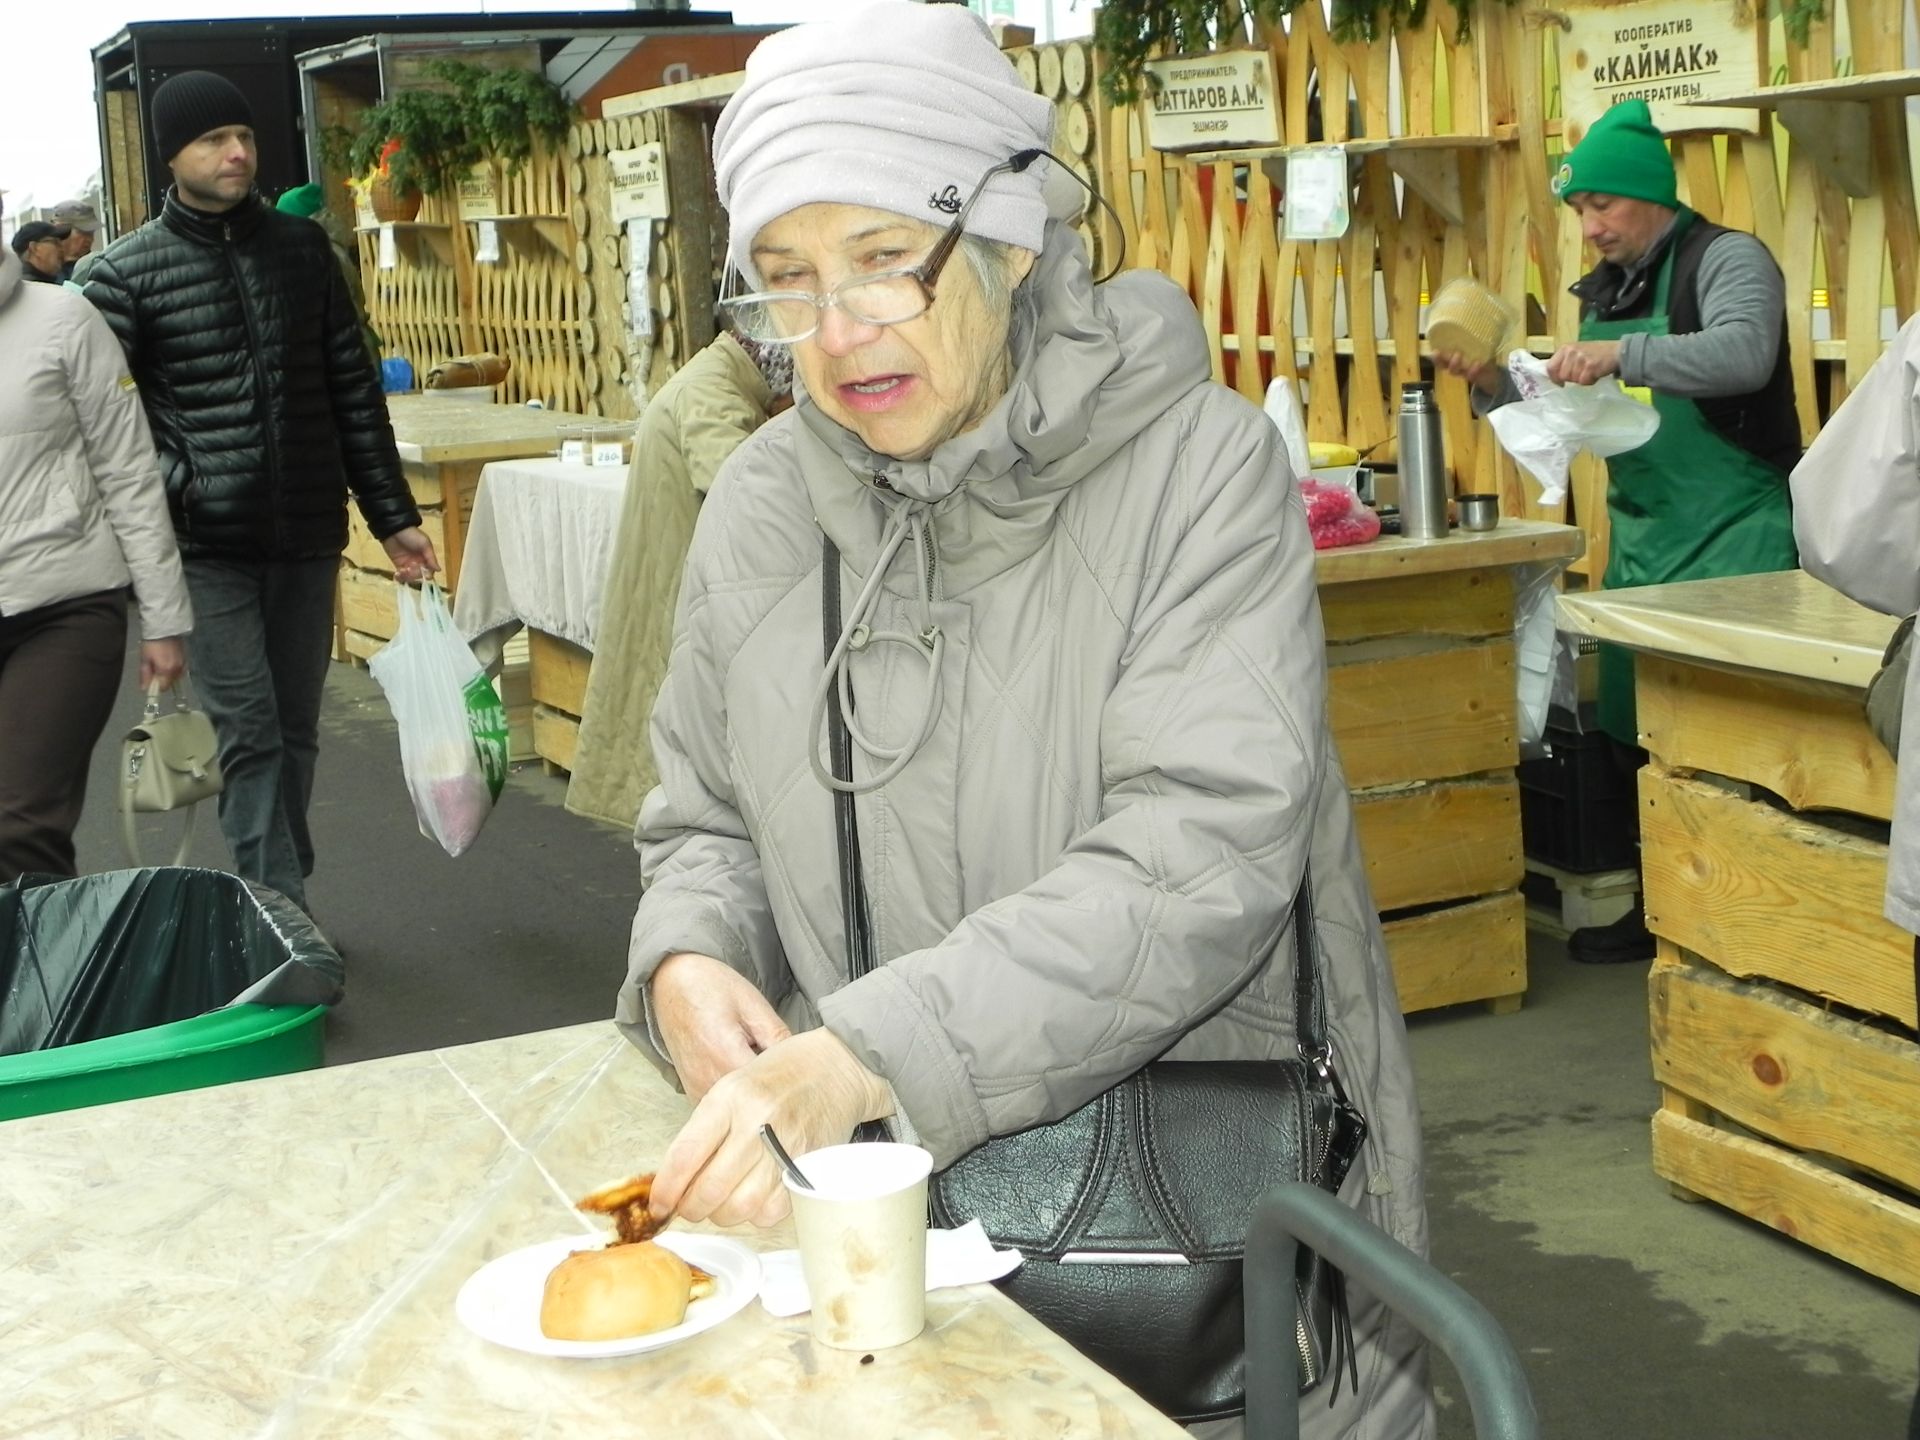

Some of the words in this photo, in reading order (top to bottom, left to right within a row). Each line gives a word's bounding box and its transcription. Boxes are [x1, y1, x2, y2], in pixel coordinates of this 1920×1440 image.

[1614, 18, 1693, 44] КООПЕРАТИВ
[1170, 65, 1238, 81] ПРЕДПРИНИМАТЕЛЬ
[1593, 43, 1719, 83] «КАЙМАК»
[1153, 86, 1227, 112] САТТАРОВ
[1231, 84, 1264, 107] А.М.
